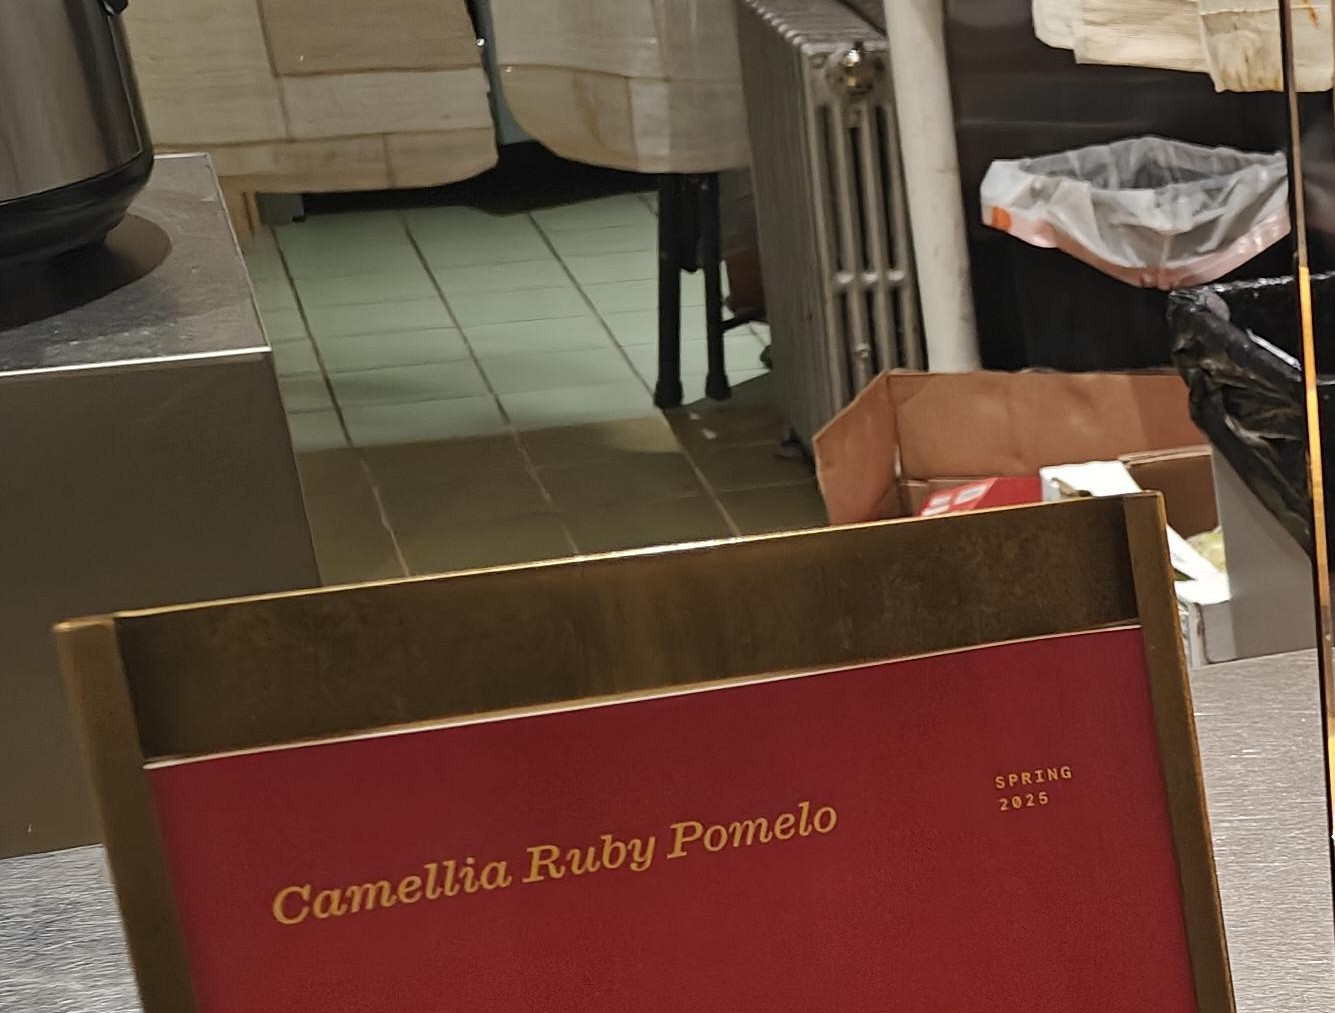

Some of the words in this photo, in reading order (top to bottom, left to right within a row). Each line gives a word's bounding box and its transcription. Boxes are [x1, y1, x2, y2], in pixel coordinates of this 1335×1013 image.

[995, 765, 1072, 789] SPRING
[999, 791, 1049, 811] 2025
[272, 856, 513, 925] Camellia
[522, 833, 657, 885] Ruby
[667, 800, 839, 860] Pomelo
